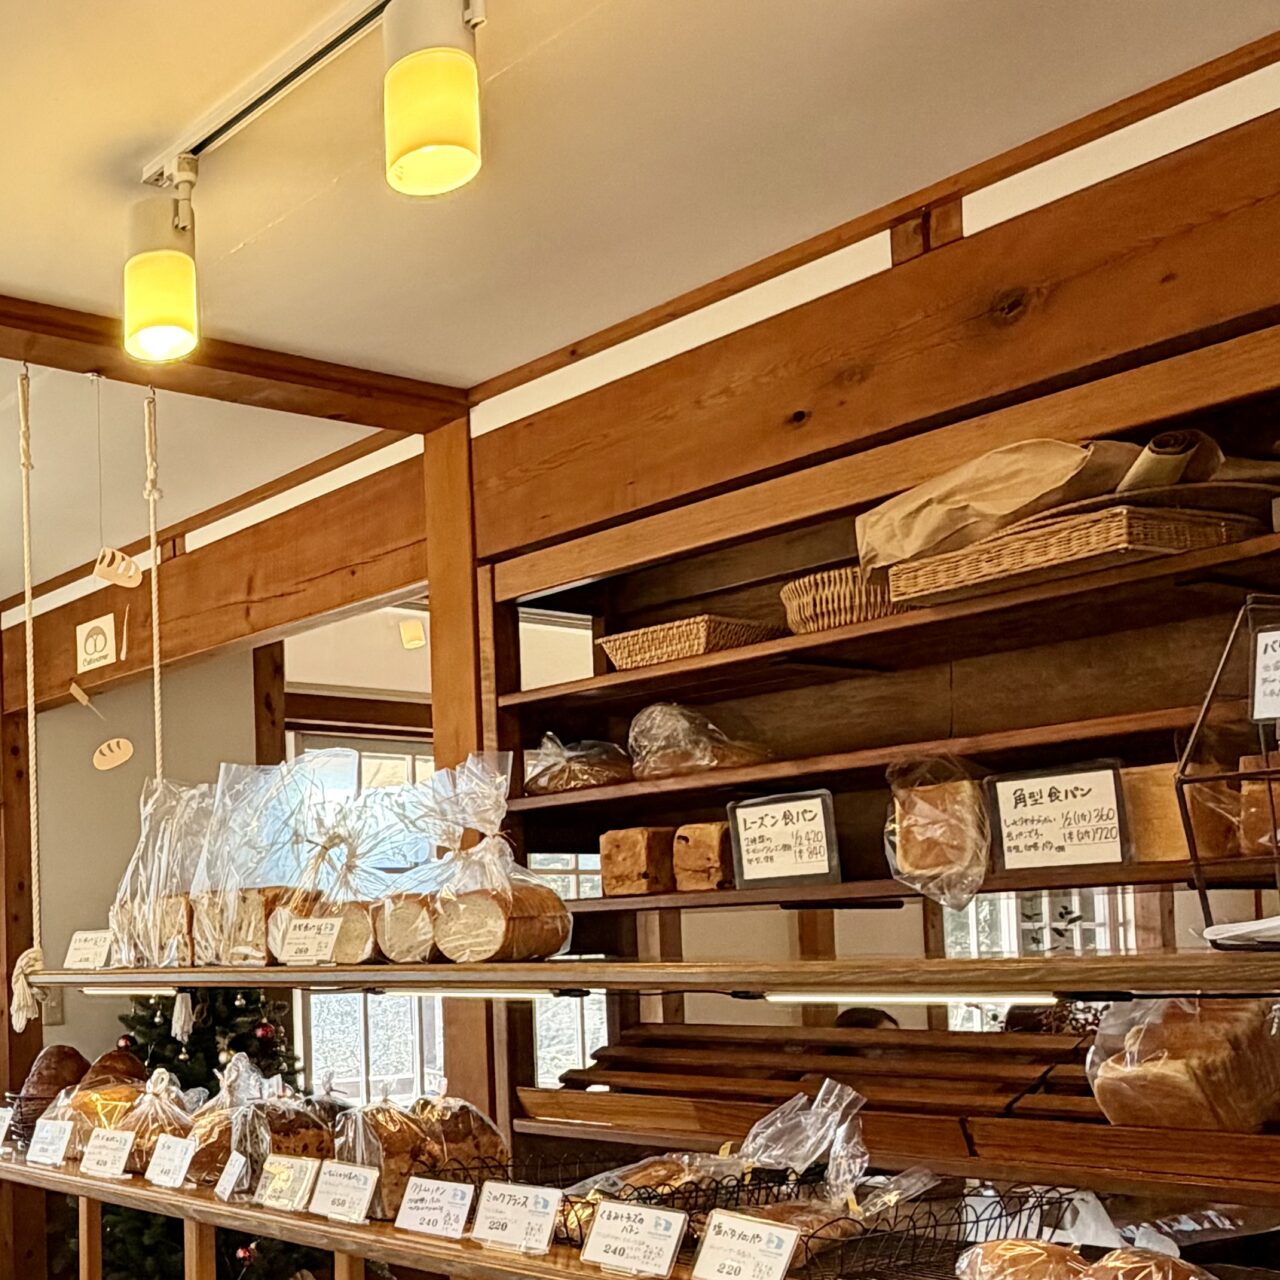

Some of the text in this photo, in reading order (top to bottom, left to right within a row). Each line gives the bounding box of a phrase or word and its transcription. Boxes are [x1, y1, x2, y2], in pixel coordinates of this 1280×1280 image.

[1093, 808, 1115, 823] 360
[804, 830, 824, 845] 420
[1096, 826, 1118, 841] 720
[806, 845, 826, 860] 840
[488, 1220, 508, 1232] 220
[603, 1244, 626, 1257] 240
[716, 1262, 742, 1277] 220
